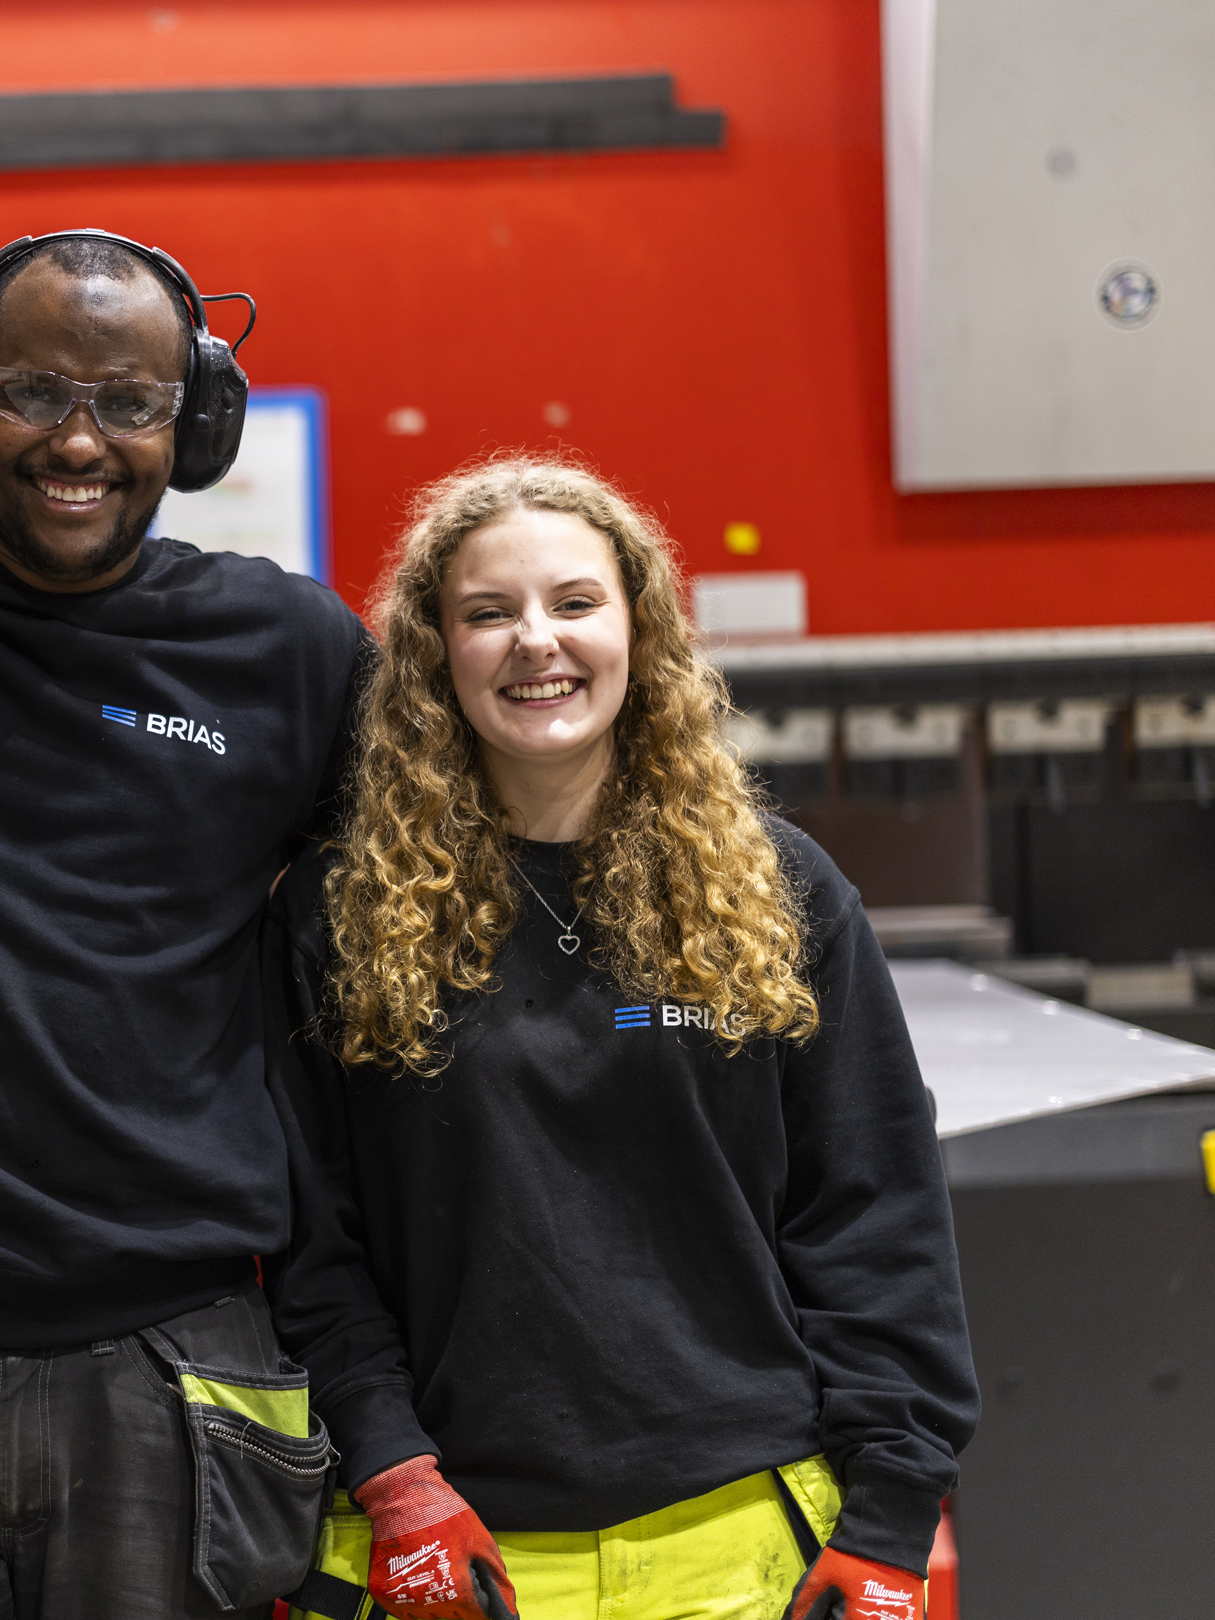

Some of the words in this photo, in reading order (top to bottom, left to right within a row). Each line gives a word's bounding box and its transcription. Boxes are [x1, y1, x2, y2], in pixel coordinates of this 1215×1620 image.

[146, 713, 226, 755] BRIAS
[387, 1542, 437, 1575] Milwaukee
[862, 1579, 910, 1600] Milwaukee
